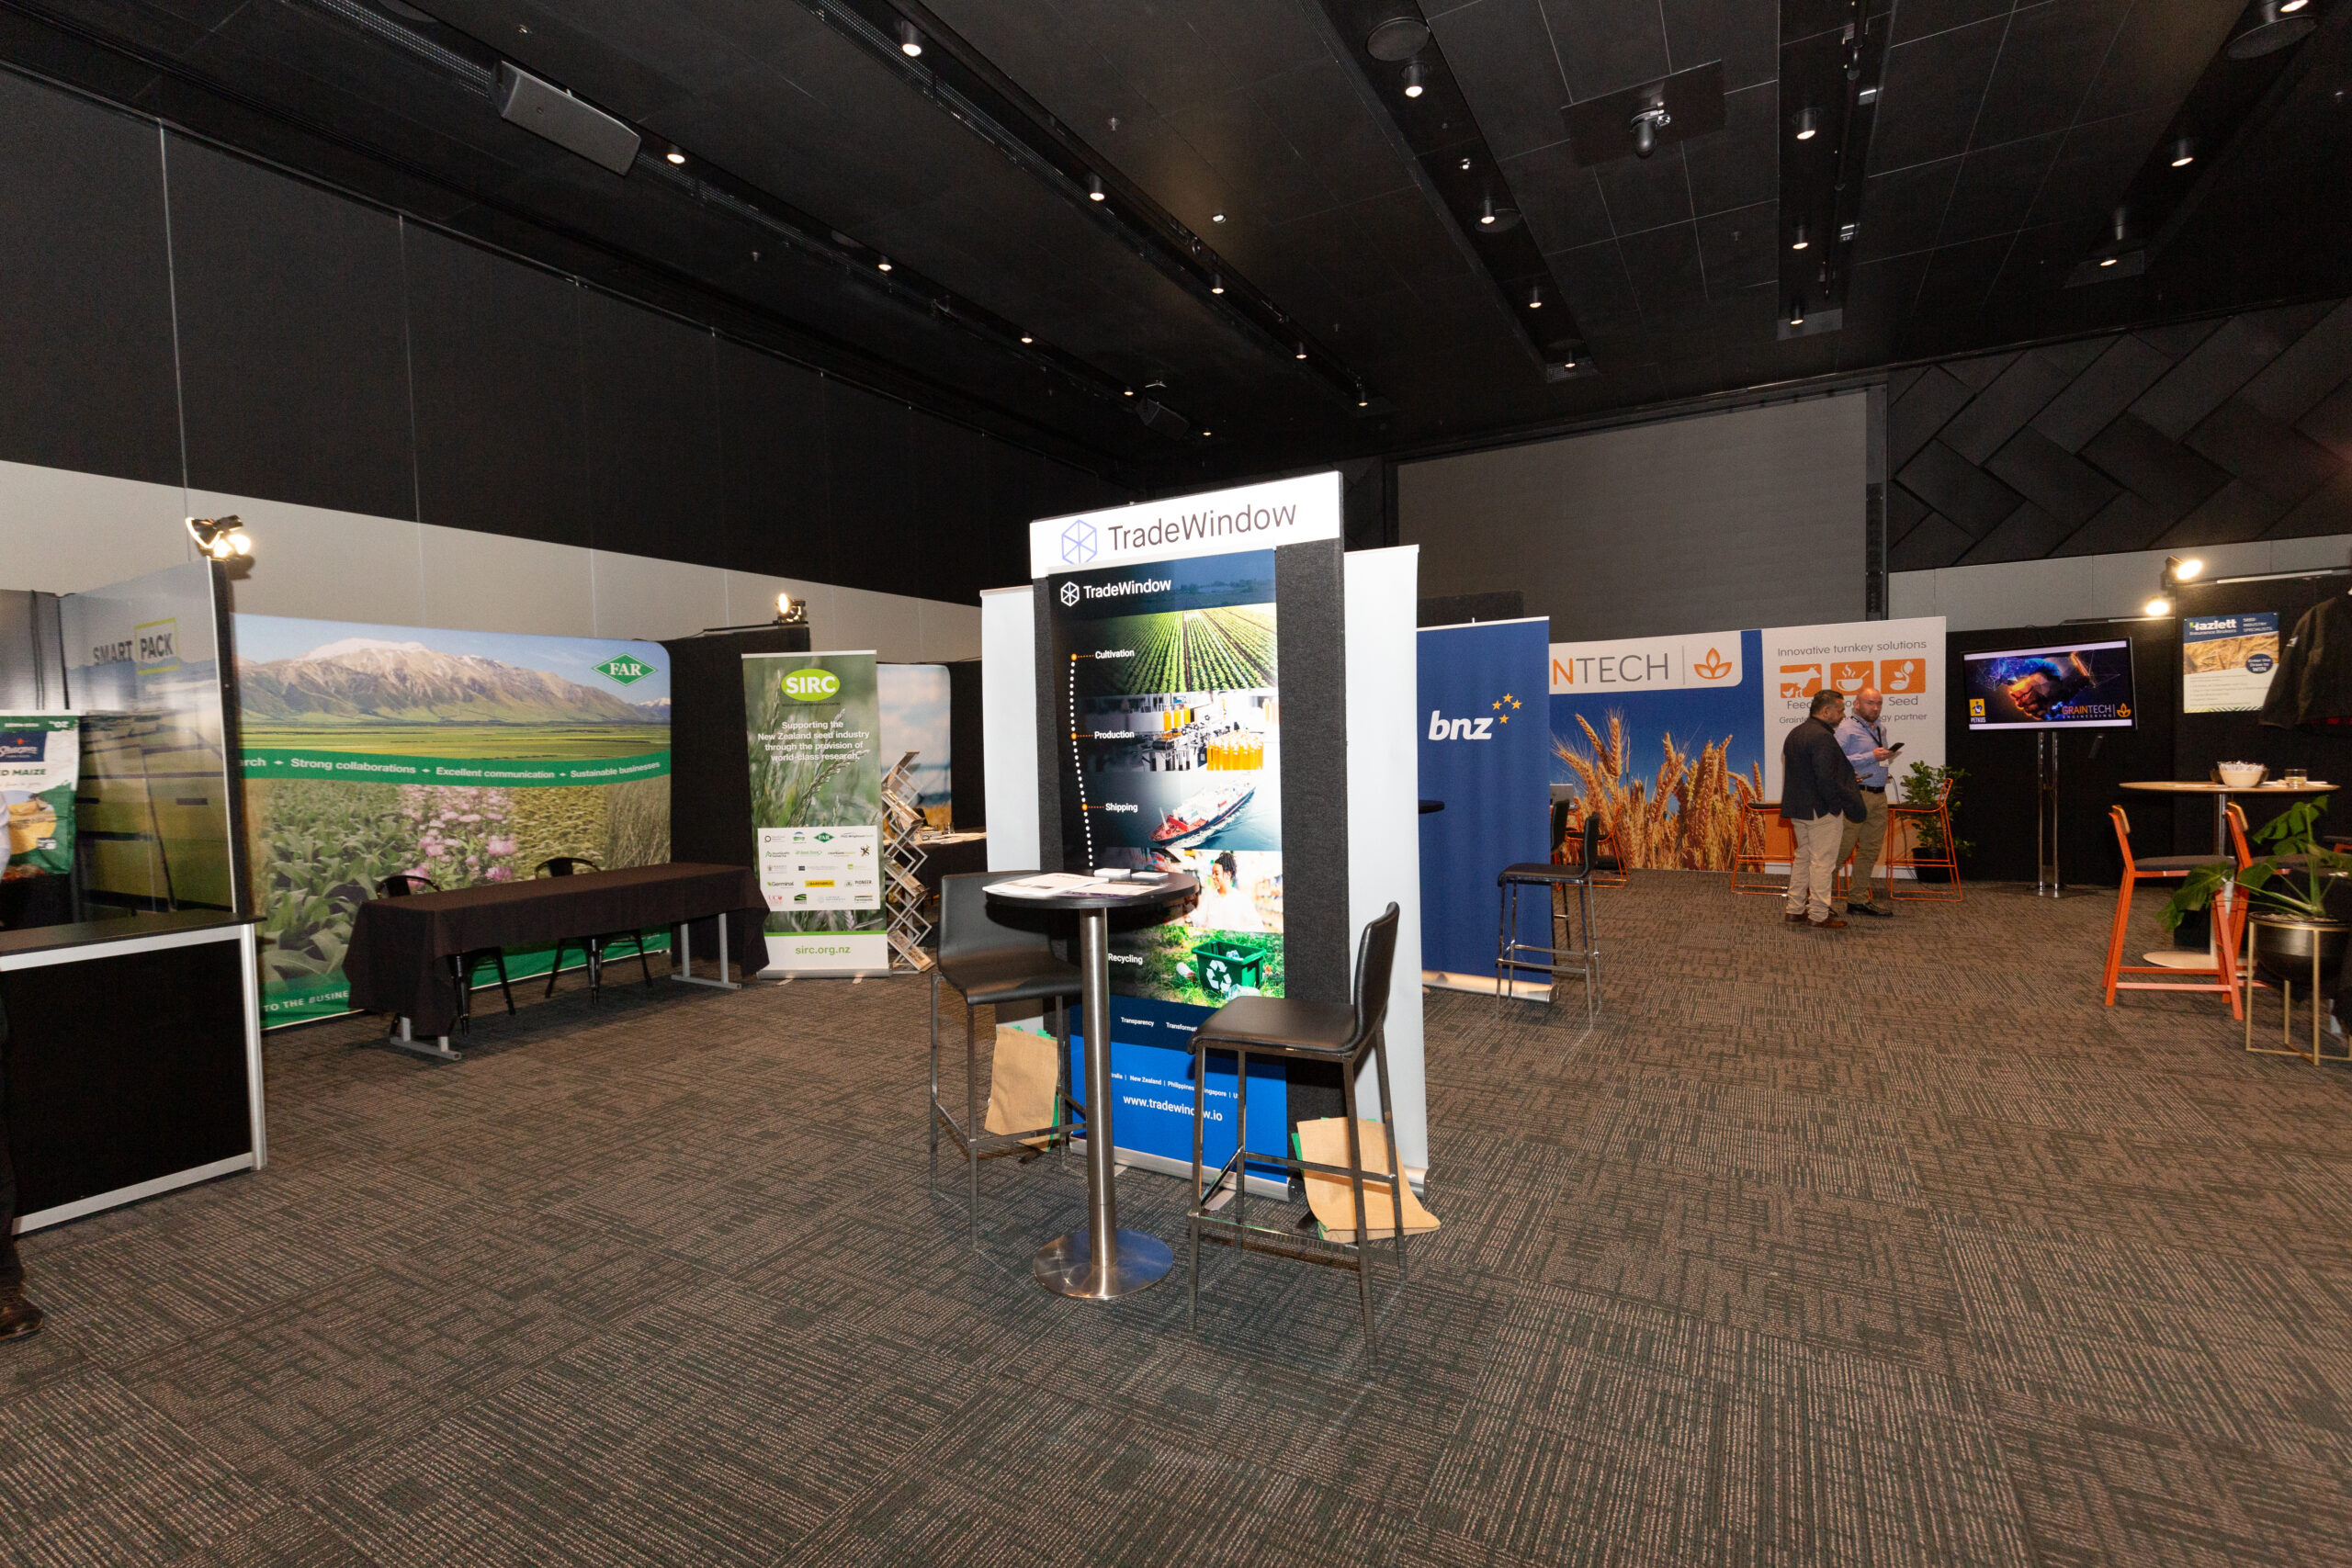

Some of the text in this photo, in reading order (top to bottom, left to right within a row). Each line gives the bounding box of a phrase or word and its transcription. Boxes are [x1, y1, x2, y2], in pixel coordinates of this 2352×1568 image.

[1108, 503, 1296, 551] TradeWindow
[1083, 578, 1171, 599] TradeWindow
[93, 633, 173, 665] SMART PACK
[1094, 648, 1135, 660] Cultivation
[1778, 640, 1927, 657] Innovative turnkey solutions
[609, 662, 642, 676] FAR
[1553, 652, 1668, 685] NTECH
[786, 675, 836, 694] SIRC
[1888, 695, 1918, 706] Seed
[2062, 705, 2111, 715] GRAINTECH
[1894, 713, 1928, 722] partner
[781, 720, 843, 730] Supporting the
[1428, 710, 1494, 741] bnz
[777, 731, 811, 740] Zealand
[835, 730, 870, 740] industry
[1094, 729, 1135, 739] Production
[764, 743, 797, 751] through
[815, 742, 853, 751] provision
[771, 753, 820, 761] world-class
[290, 758, 333, 771] Strong
[335, 761, 416, 773] collaborations
[435, 766, 482, 777] Excellent
[483, 769, 555, 779] communication
[570, 767, 617, 778] Sustainable
[618, 761, 661, 774] businesses
[1105, 802, 1138, 813] Shipping
[795, 943, 851, 955] sirc.org.nz
[1108, 953, 1143, 965] Recycling
[282, 998, 305, 1009] THE
[309, 990, 349, 1004] BUSINE
[1121, 1016, 1154, 1027] Transparency
[1142, 1076, 1162, 1085] Zealand
[1204, 1088, 1227, 1098] ingapore
